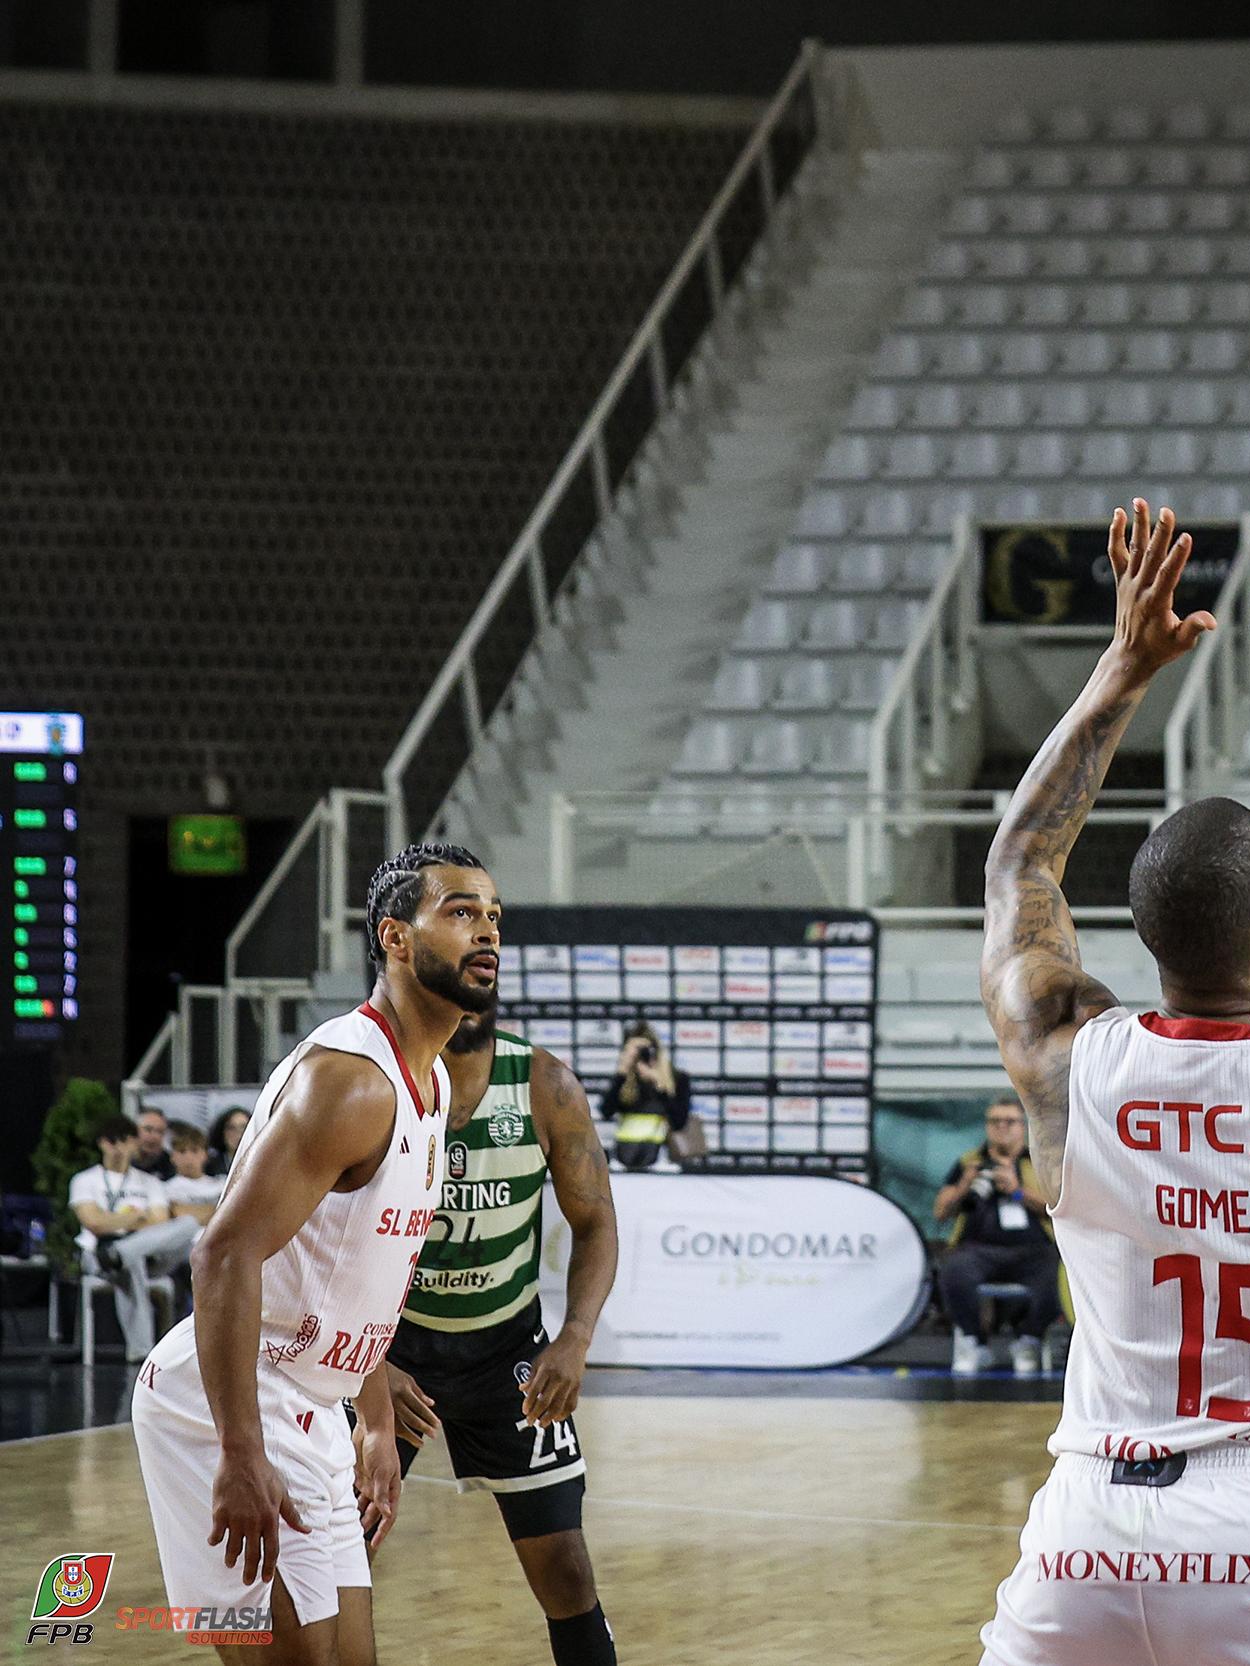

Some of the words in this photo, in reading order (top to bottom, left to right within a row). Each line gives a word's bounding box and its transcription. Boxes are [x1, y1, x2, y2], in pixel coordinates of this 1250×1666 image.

[443, 1182, 511, 1210] RTING
[376, 1207, 401, 1236] SL
[660, 1224, 878, 1260] GONDOMAR
[515, 1418, 578, 1469] 24
